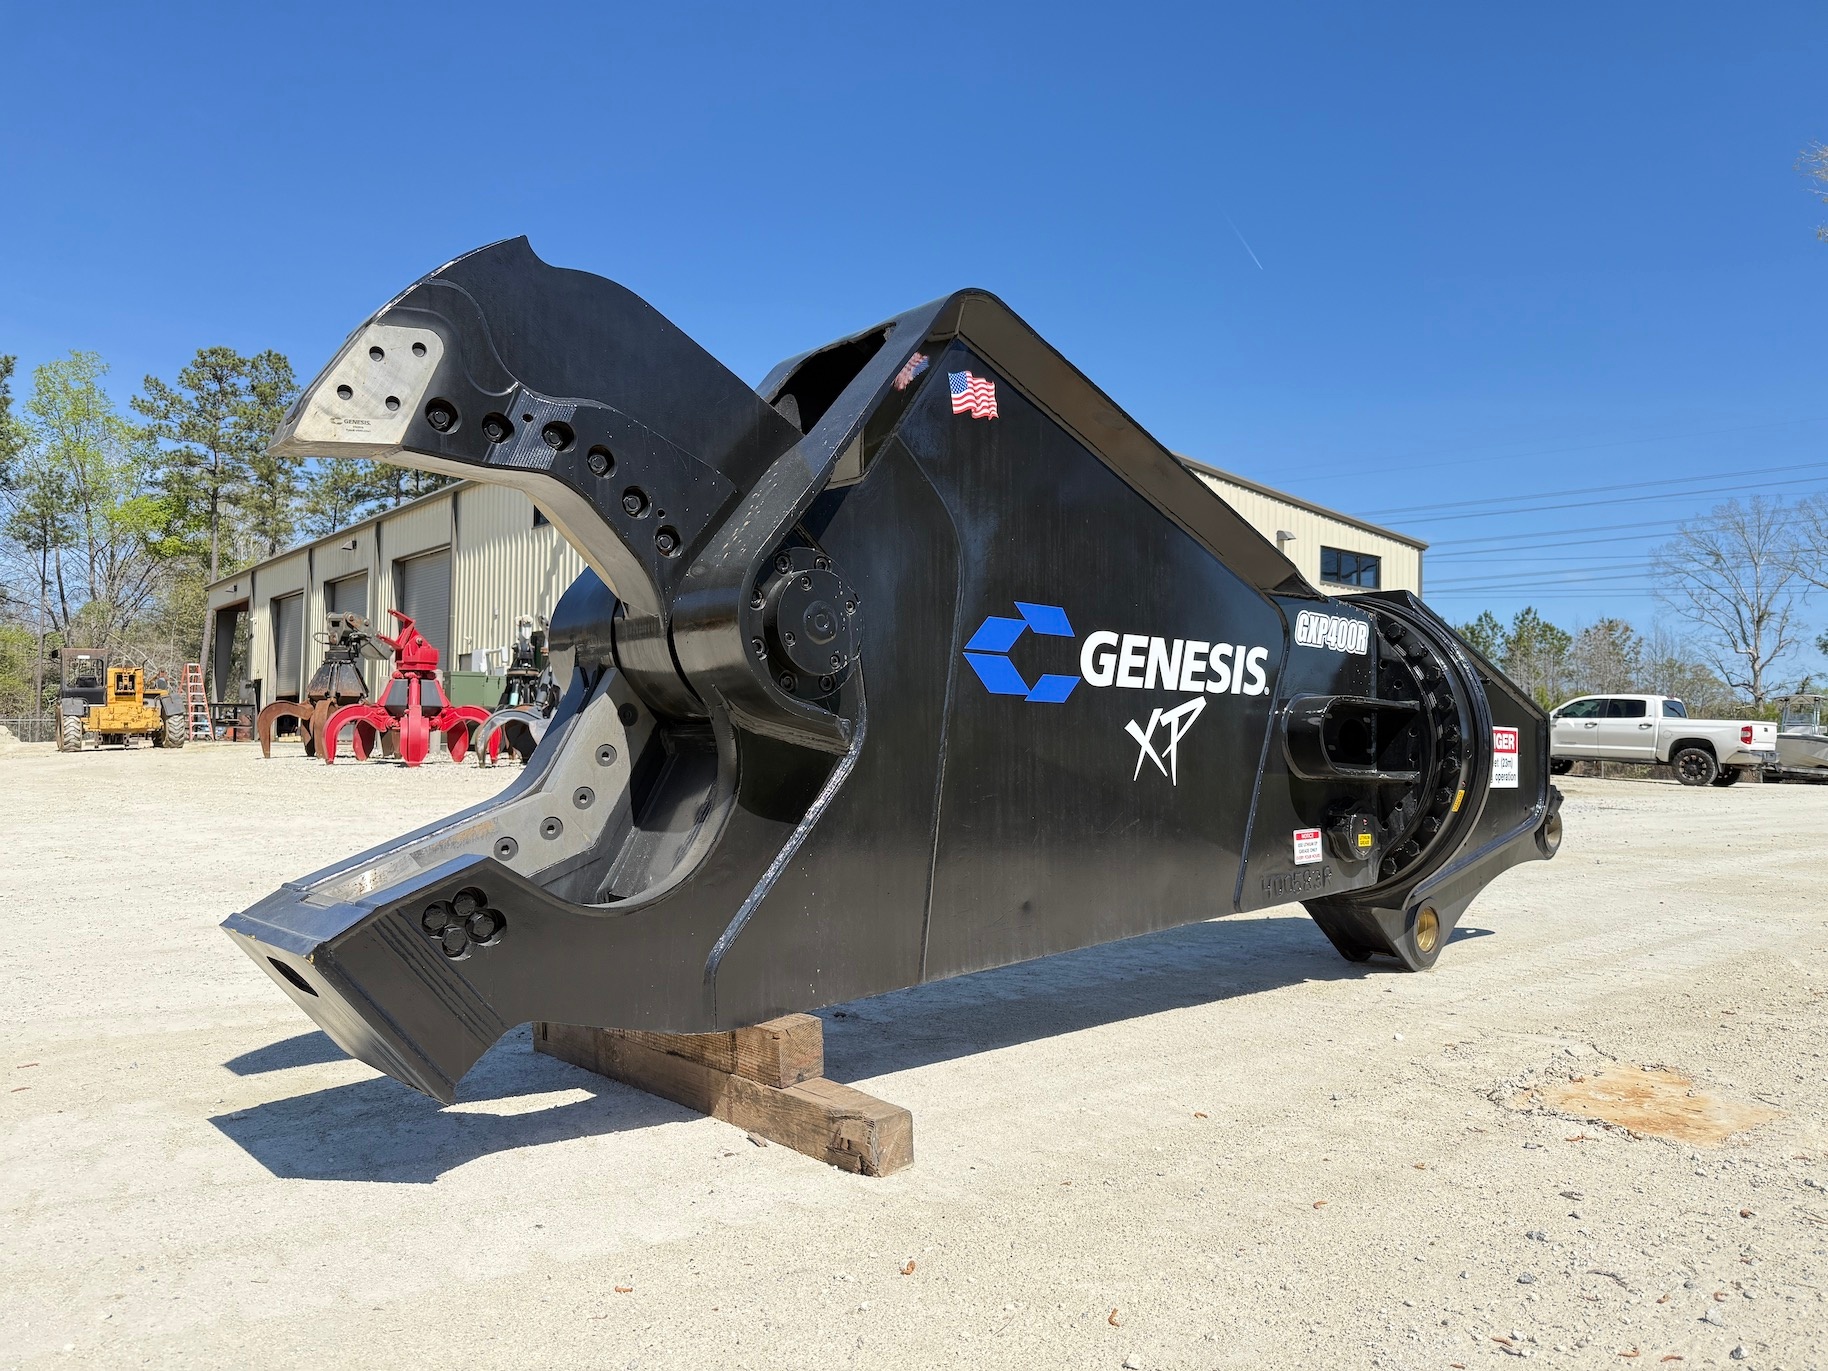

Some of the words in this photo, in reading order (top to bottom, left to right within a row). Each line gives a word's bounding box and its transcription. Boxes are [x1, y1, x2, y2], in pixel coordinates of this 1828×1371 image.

[1295, 610, 1369, 655] GXP400R
[1080, 630, 1269, 696] GENESIS
[1124, 696, 1207, 786] XP
[1501, 757, 1513, 769] (23m)
[1495, 772, 1516, 783] operation
